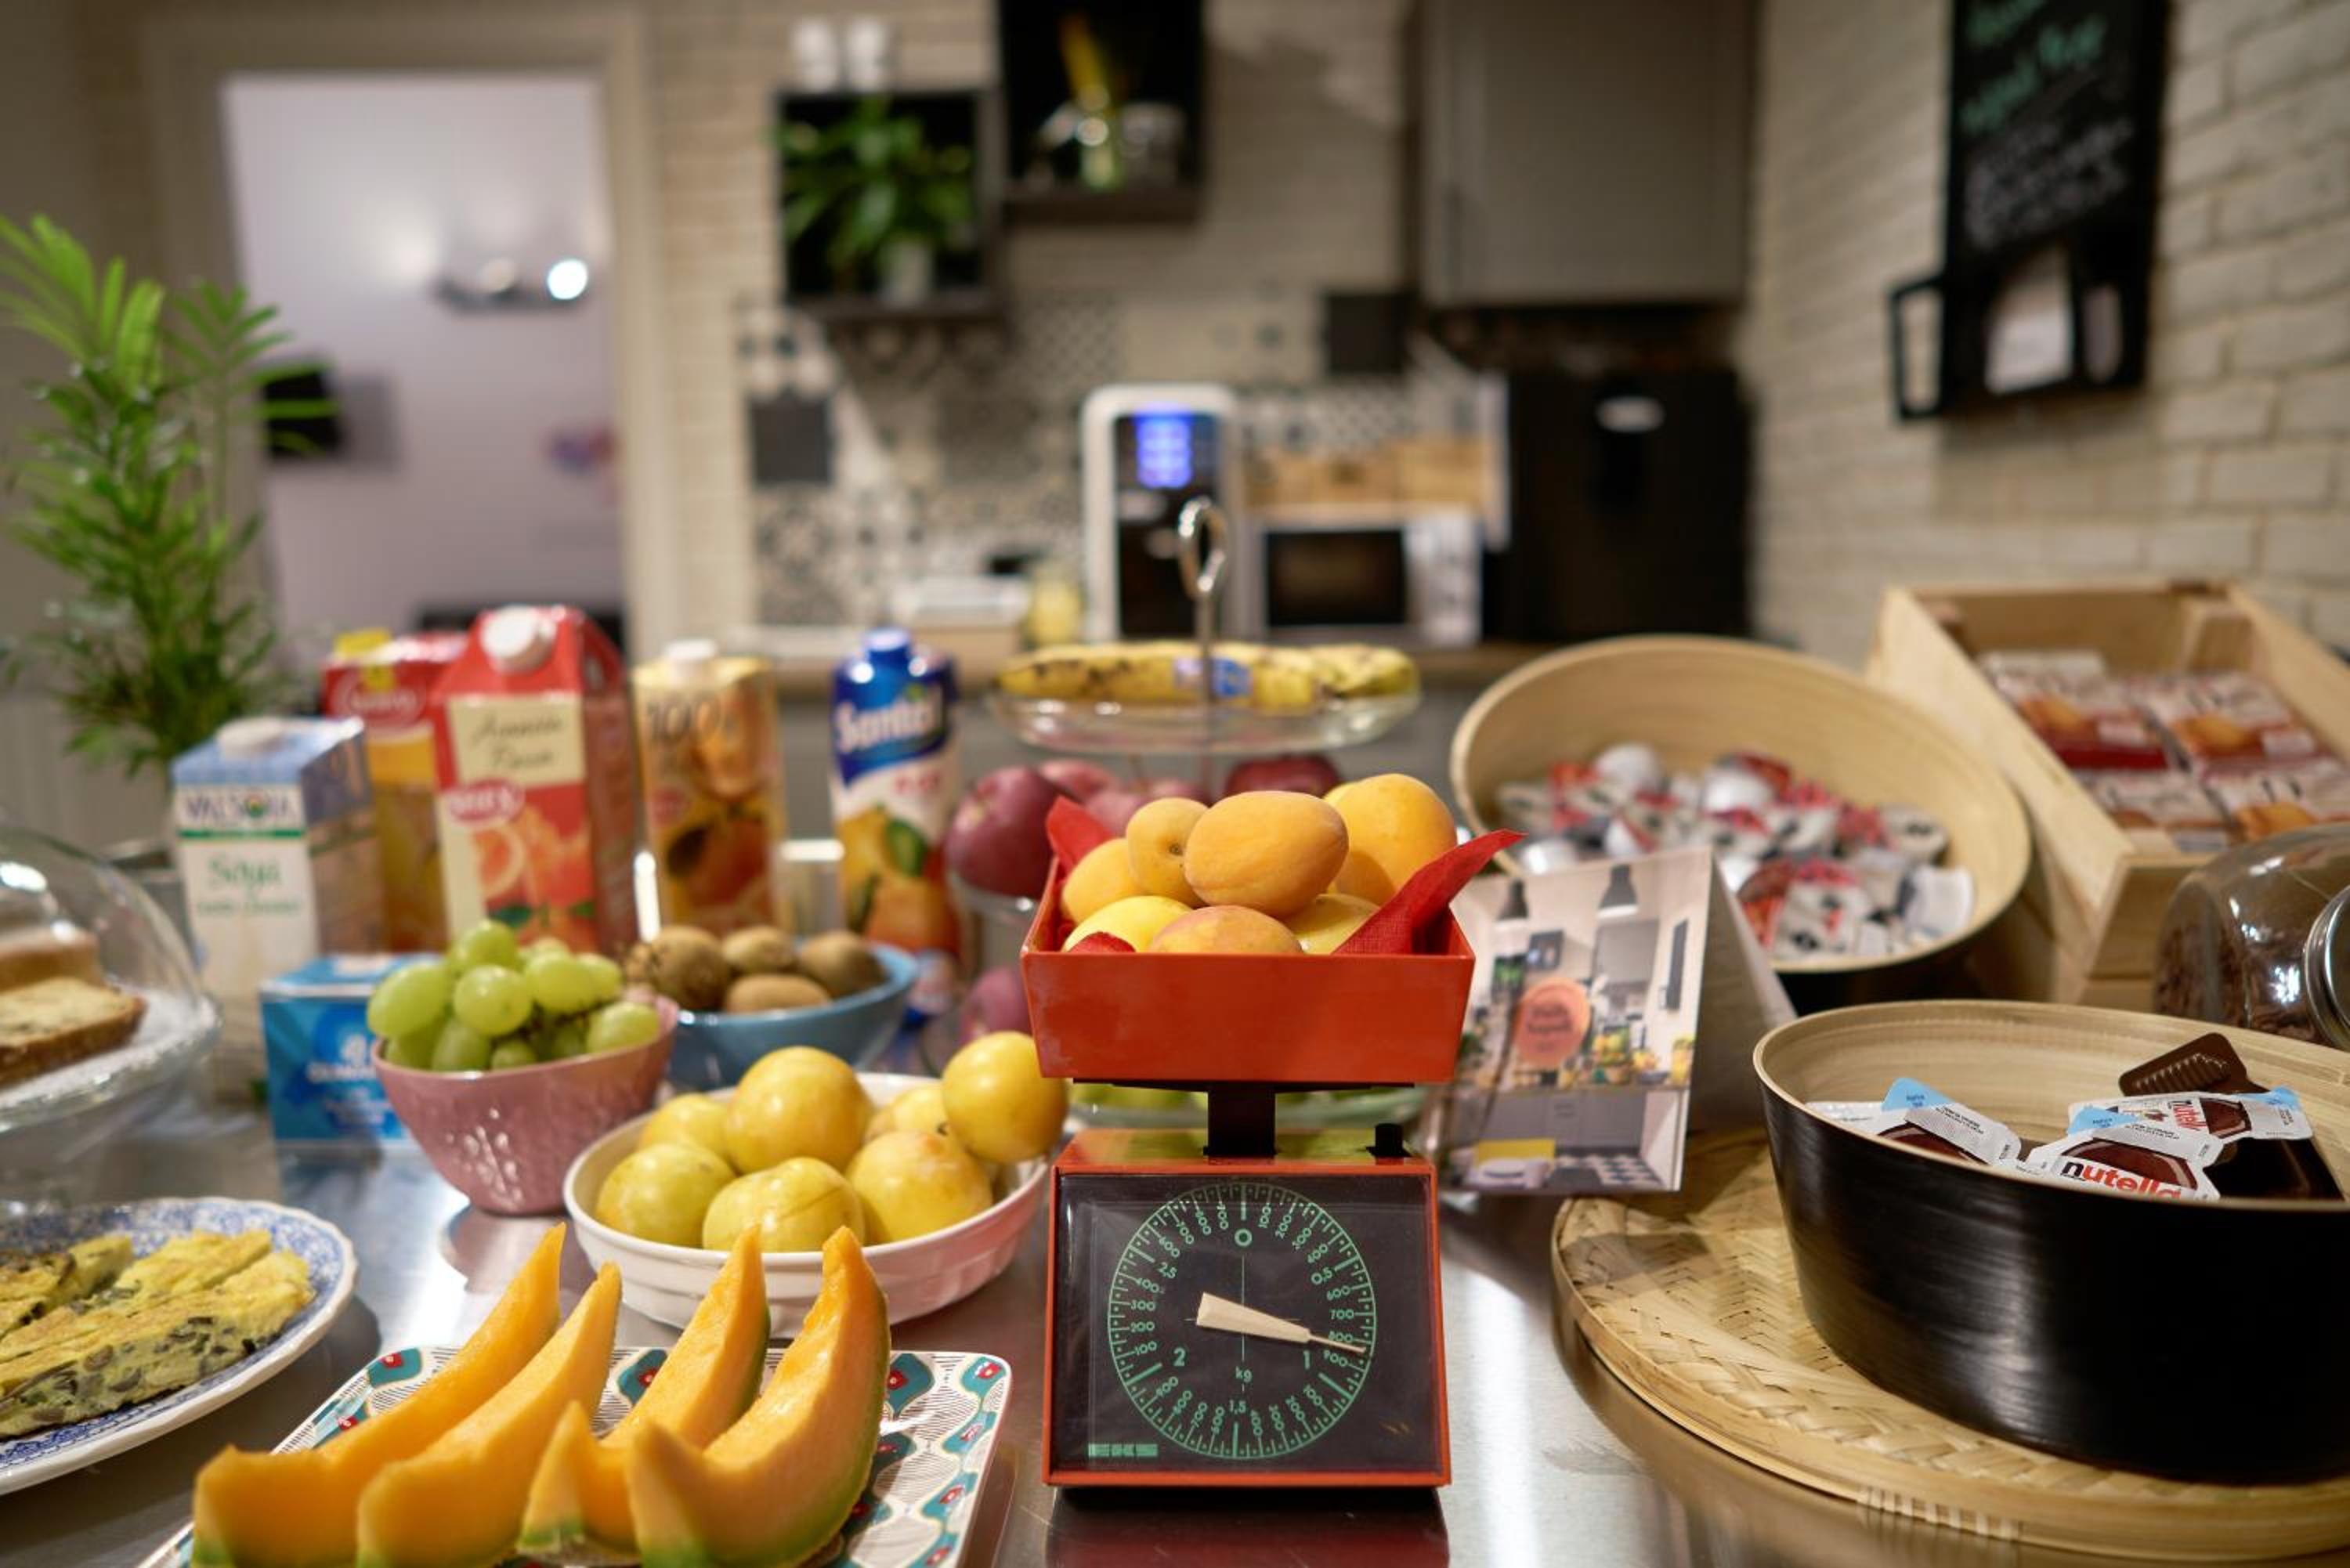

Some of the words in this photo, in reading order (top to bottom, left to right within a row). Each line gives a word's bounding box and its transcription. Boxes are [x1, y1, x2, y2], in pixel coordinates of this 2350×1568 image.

[2060, 1162, 2182, 1199] nutella
[1258, 1205, 1271, 1228] 100
[1274, 1215, 1292, 1239] 200
[1159, 1236, 1180, 1258] 600
[1292, 1227, 1311, 1250] 300
[1307, 1244, 1329, 1263] 400
[1136, 1277, 1159, 1293] 400
[1326, 1285, 1351, 1301] 600
[1130, 1299, 1156, 1312] 300
[1329, 1308, 1354, 1321] 700
[1130, 1321, 1155, 1333] 200
[1135, 1340, 1158, 1356] 100
[1173, 1346, 1186, 1367] 2
[1324, 1349, 1348, 1367] 900
[1303, 1349, 1311, 1370] 1
[1235, 1365, 1253, 1382] kg
[1303, 1384, 1323, 1407] 100
[1191, 1402, 1208, 1428] 700
[1269, 1404, 1284, 1431] 300
[1285, 1395, 1305, 1421] 200
